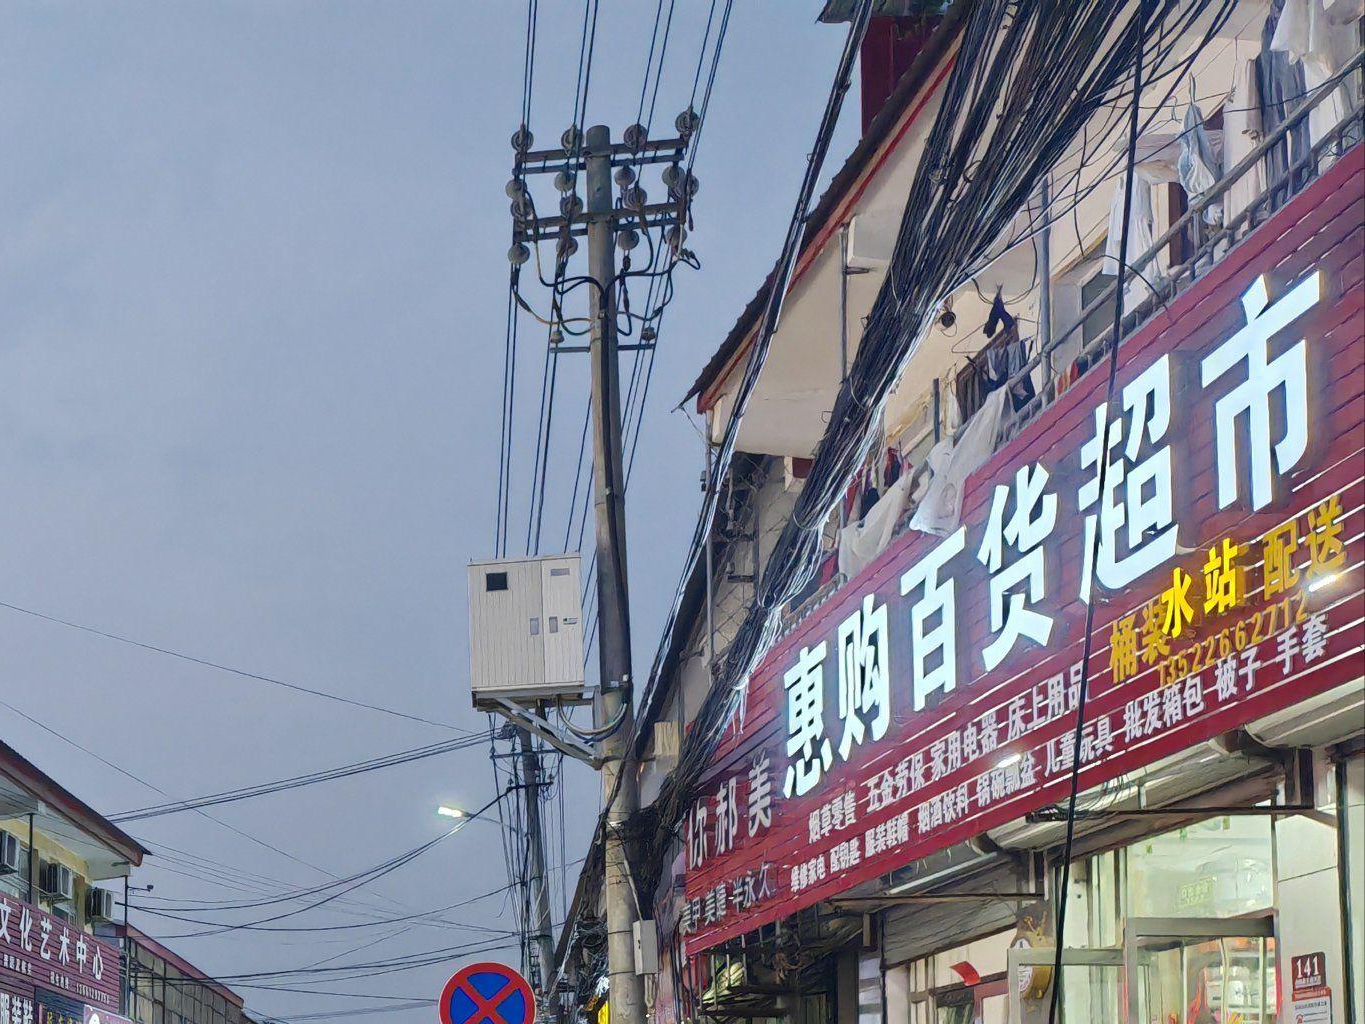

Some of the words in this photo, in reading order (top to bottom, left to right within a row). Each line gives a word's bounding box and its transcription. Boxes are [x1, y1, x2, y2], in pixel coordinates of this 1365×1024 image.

[783, 270, 1320, 798] 惠购百货超市
[1122, 675, 1207, 742] 批发箱包
[1277, 614, 1329, 676] 手套
[1158, 589, 1309, 688] 13522662712
[1296, 956, 1320, 978] 141
